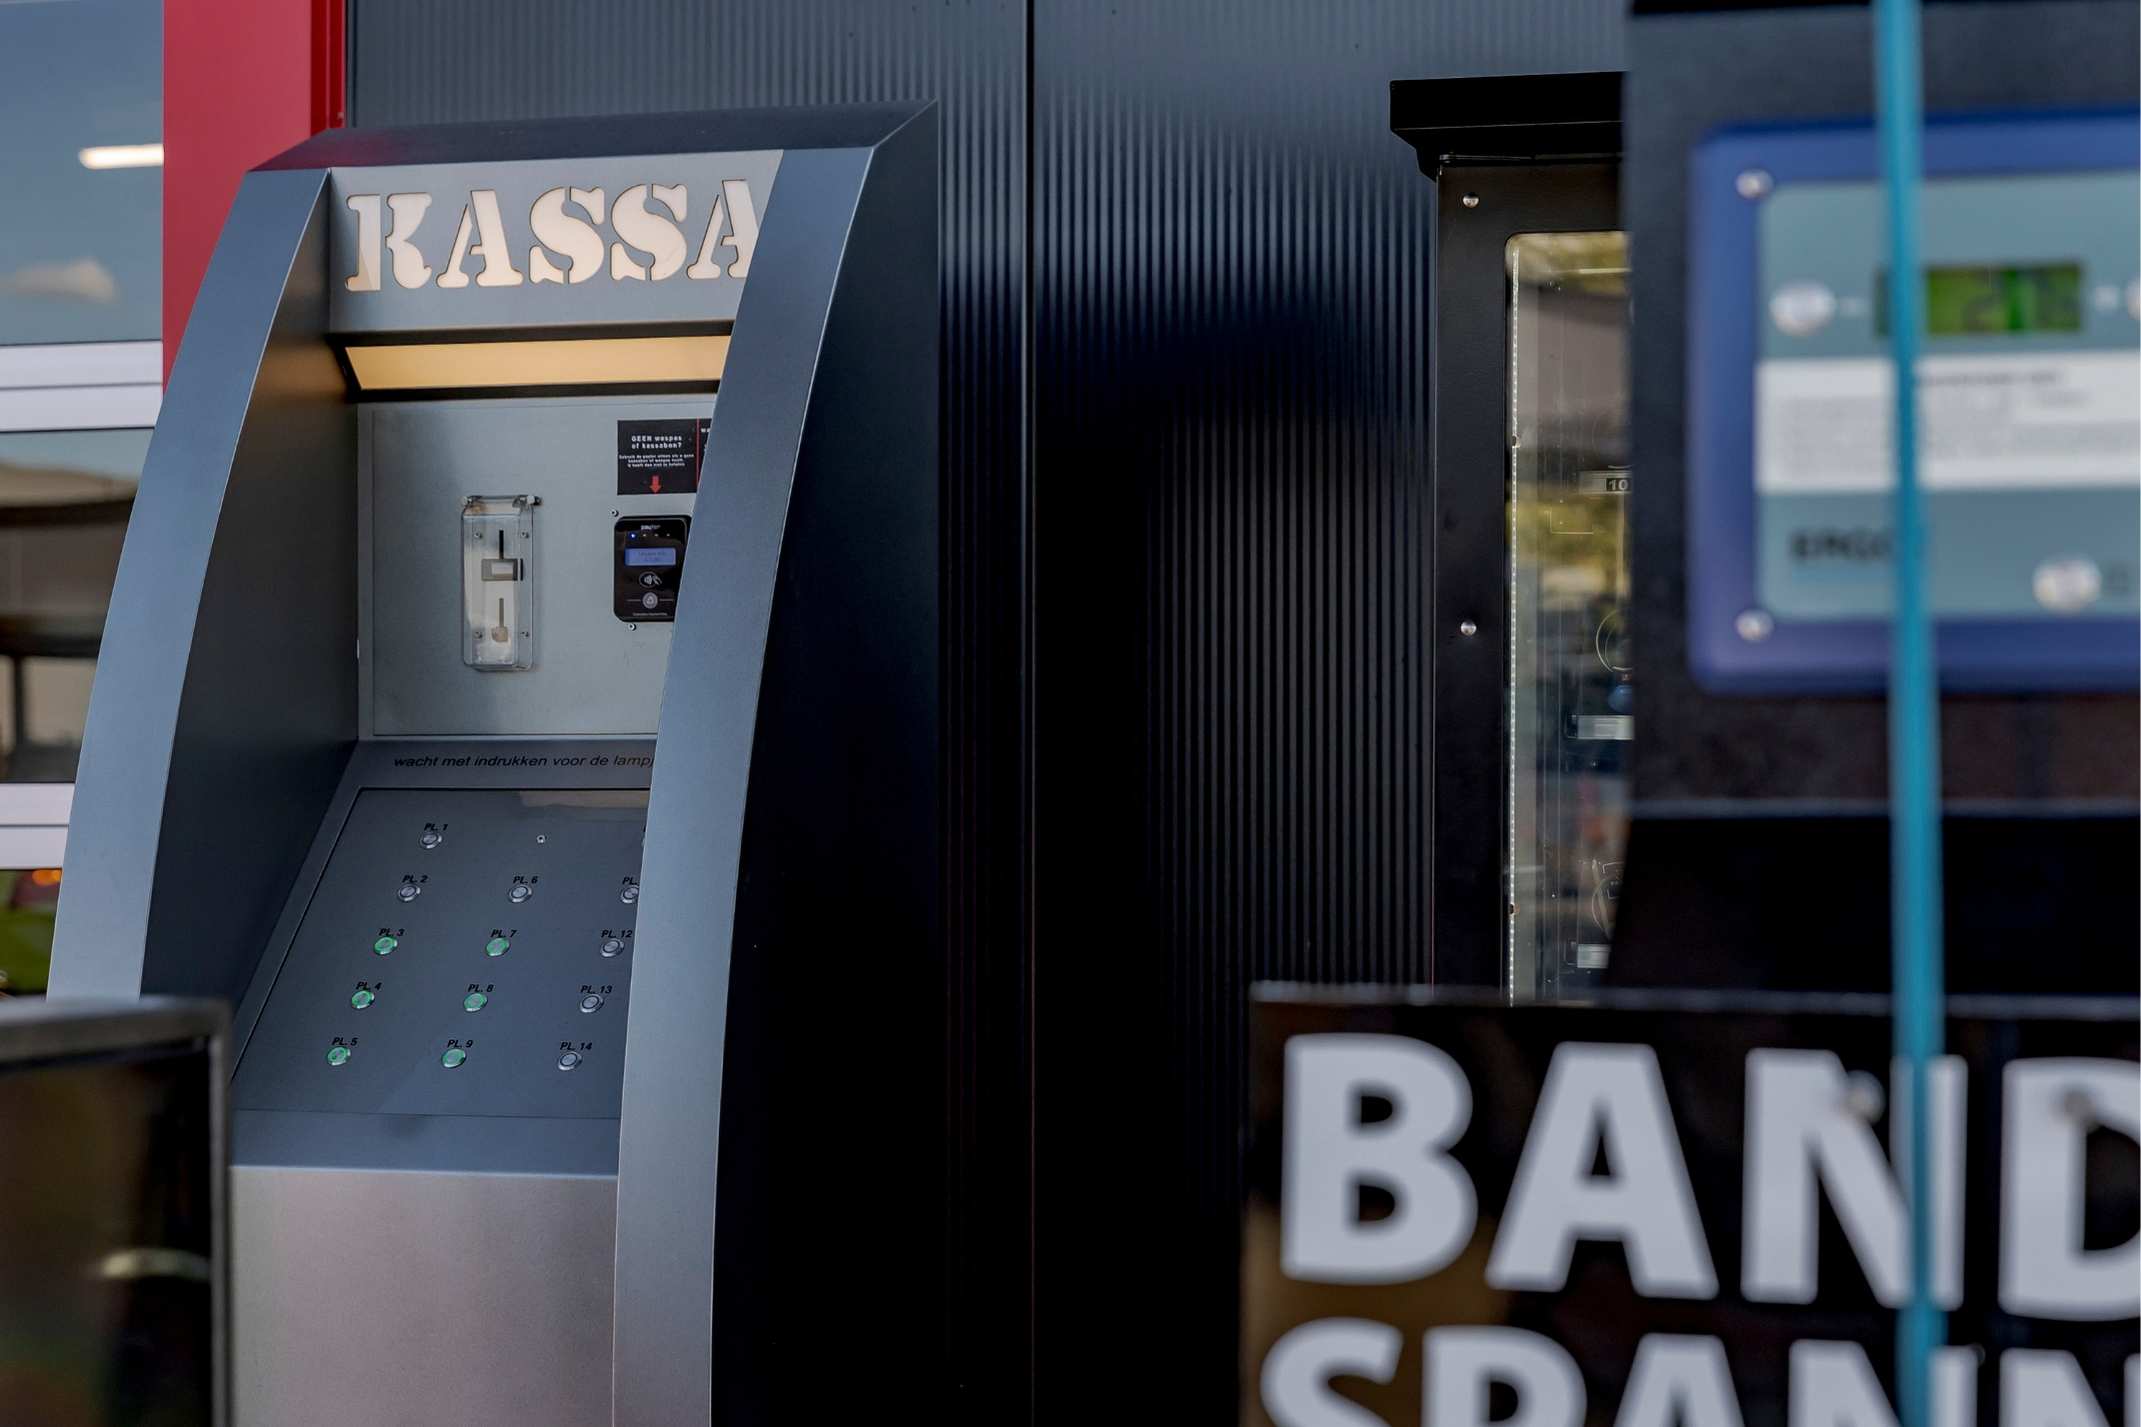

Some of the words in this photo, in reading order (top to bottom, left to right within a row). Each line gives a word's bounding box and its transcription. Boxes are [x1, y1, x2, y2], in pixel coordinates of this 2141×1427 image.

[345, 179, 758, 292] KASSA
[1608, 479, 1629, 491] 10
[394, 756, 439, 767] wacht
[441, 756, 471, 767] met
[474, 756, 547, 767] indrukken
[553, 757, 586, 767] voor
[590, 755, 609, 767] de
[442, 823, 448, 831] 1
[419, 875, 428, 883] 2
[530, 876, 538, 884] 6
[396, 928, 404, 937] 3
[510, 930, 517, 938] 7
[619, 930, 632, 938] 12
[373, 982, 381, 990] 4
[485, 984, 493, 992] 8
[599, 985, 612, 993] 13
[349, 1038, 357, 1046] 5
[465, 1040, 473, 1048] 9
[578, 1042, 592, 1050] 14
[1281, 1033, 2141, 1321] BAND
